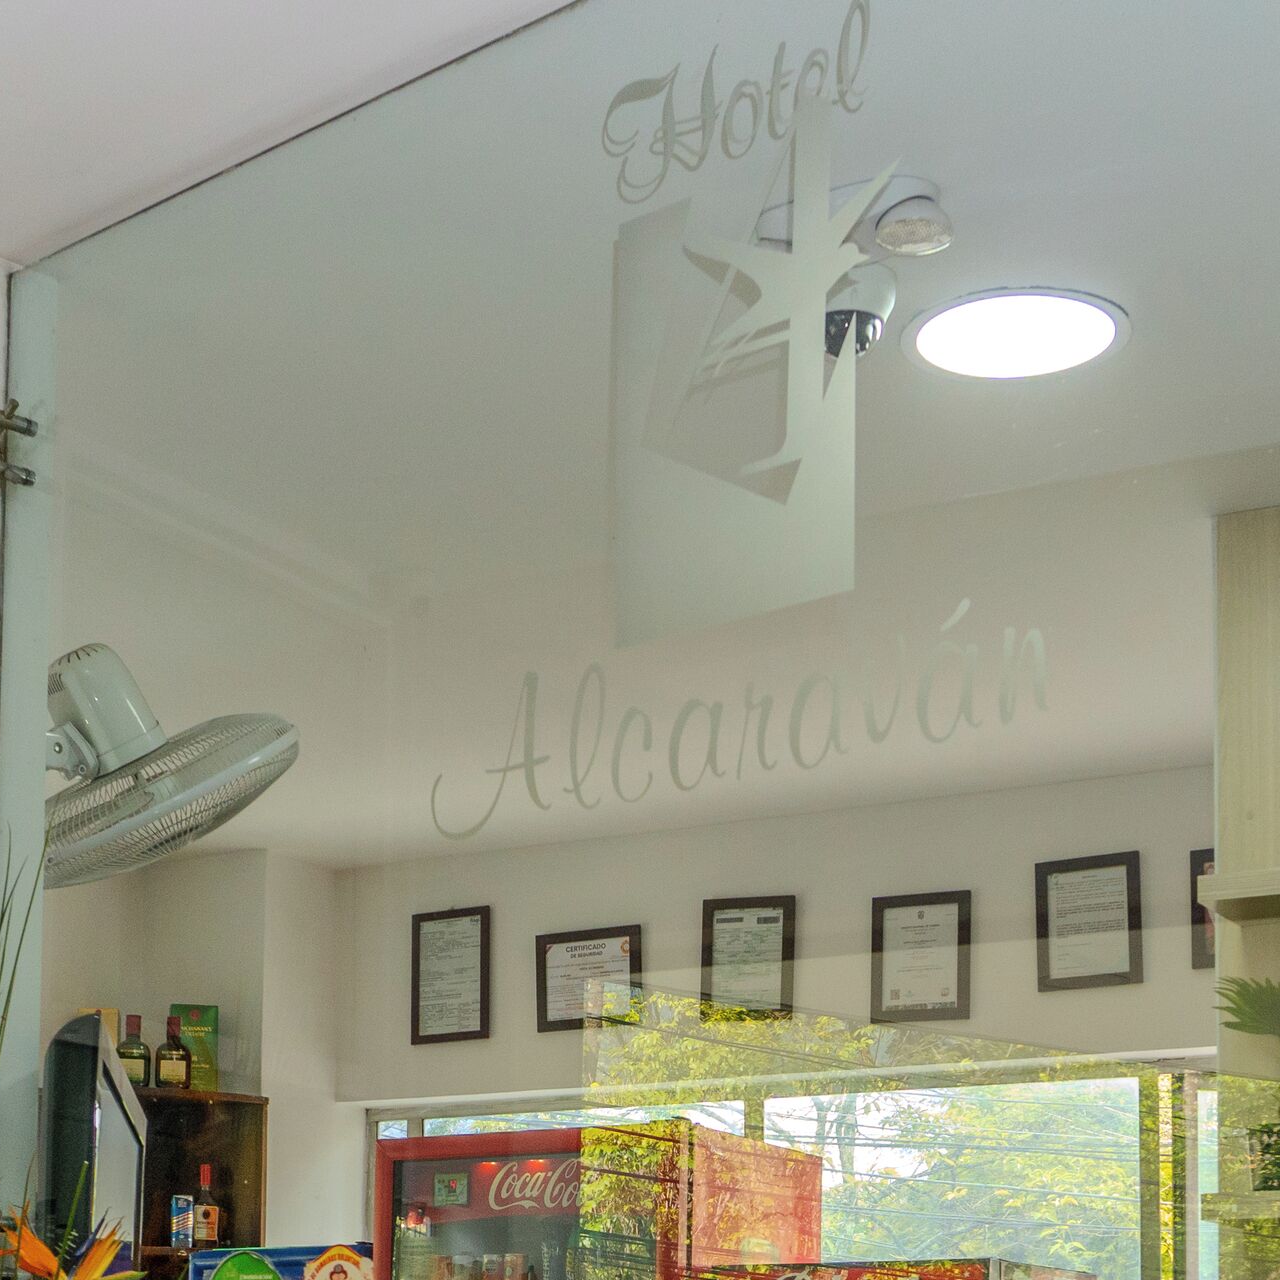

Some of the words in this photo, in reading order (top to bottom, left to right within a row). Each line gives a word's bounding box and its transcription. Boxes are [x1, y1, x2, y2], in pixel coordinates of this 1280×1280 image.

[602, 0, 871, 204] Hotel
[431, 598, 1049, 841] Alcaraván
[566, 943, 607, 953] CERTIFICADO
